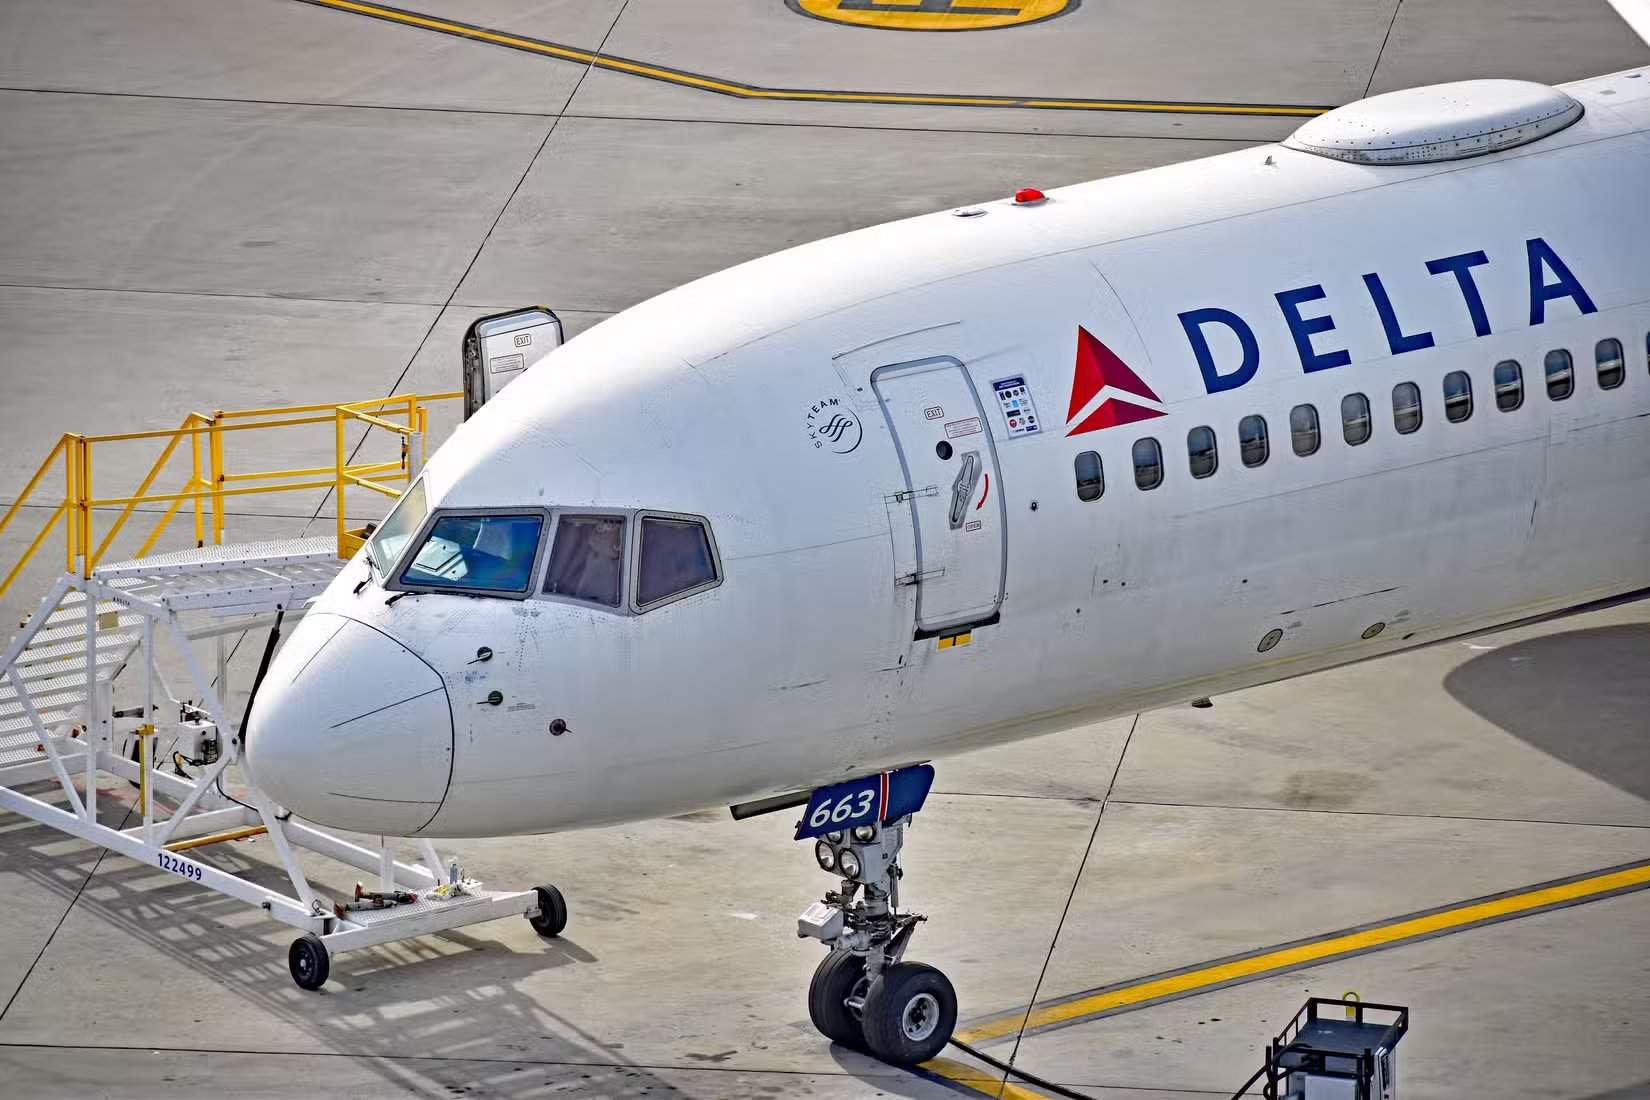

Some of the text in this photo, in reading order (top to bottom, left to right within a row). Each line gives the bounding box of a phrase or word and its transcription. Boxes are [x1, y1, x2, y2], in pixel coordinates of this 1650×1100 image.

[1177, 238, 1598, 394] DELTA
[516, 335, 529, 345] EXIT
[807, 398, 839, 448] SKYTEAM
[926, 408, 941, 418] EXIT
[810, 789, 875, 827] 663
[158, 853, 202, 880] 122499
